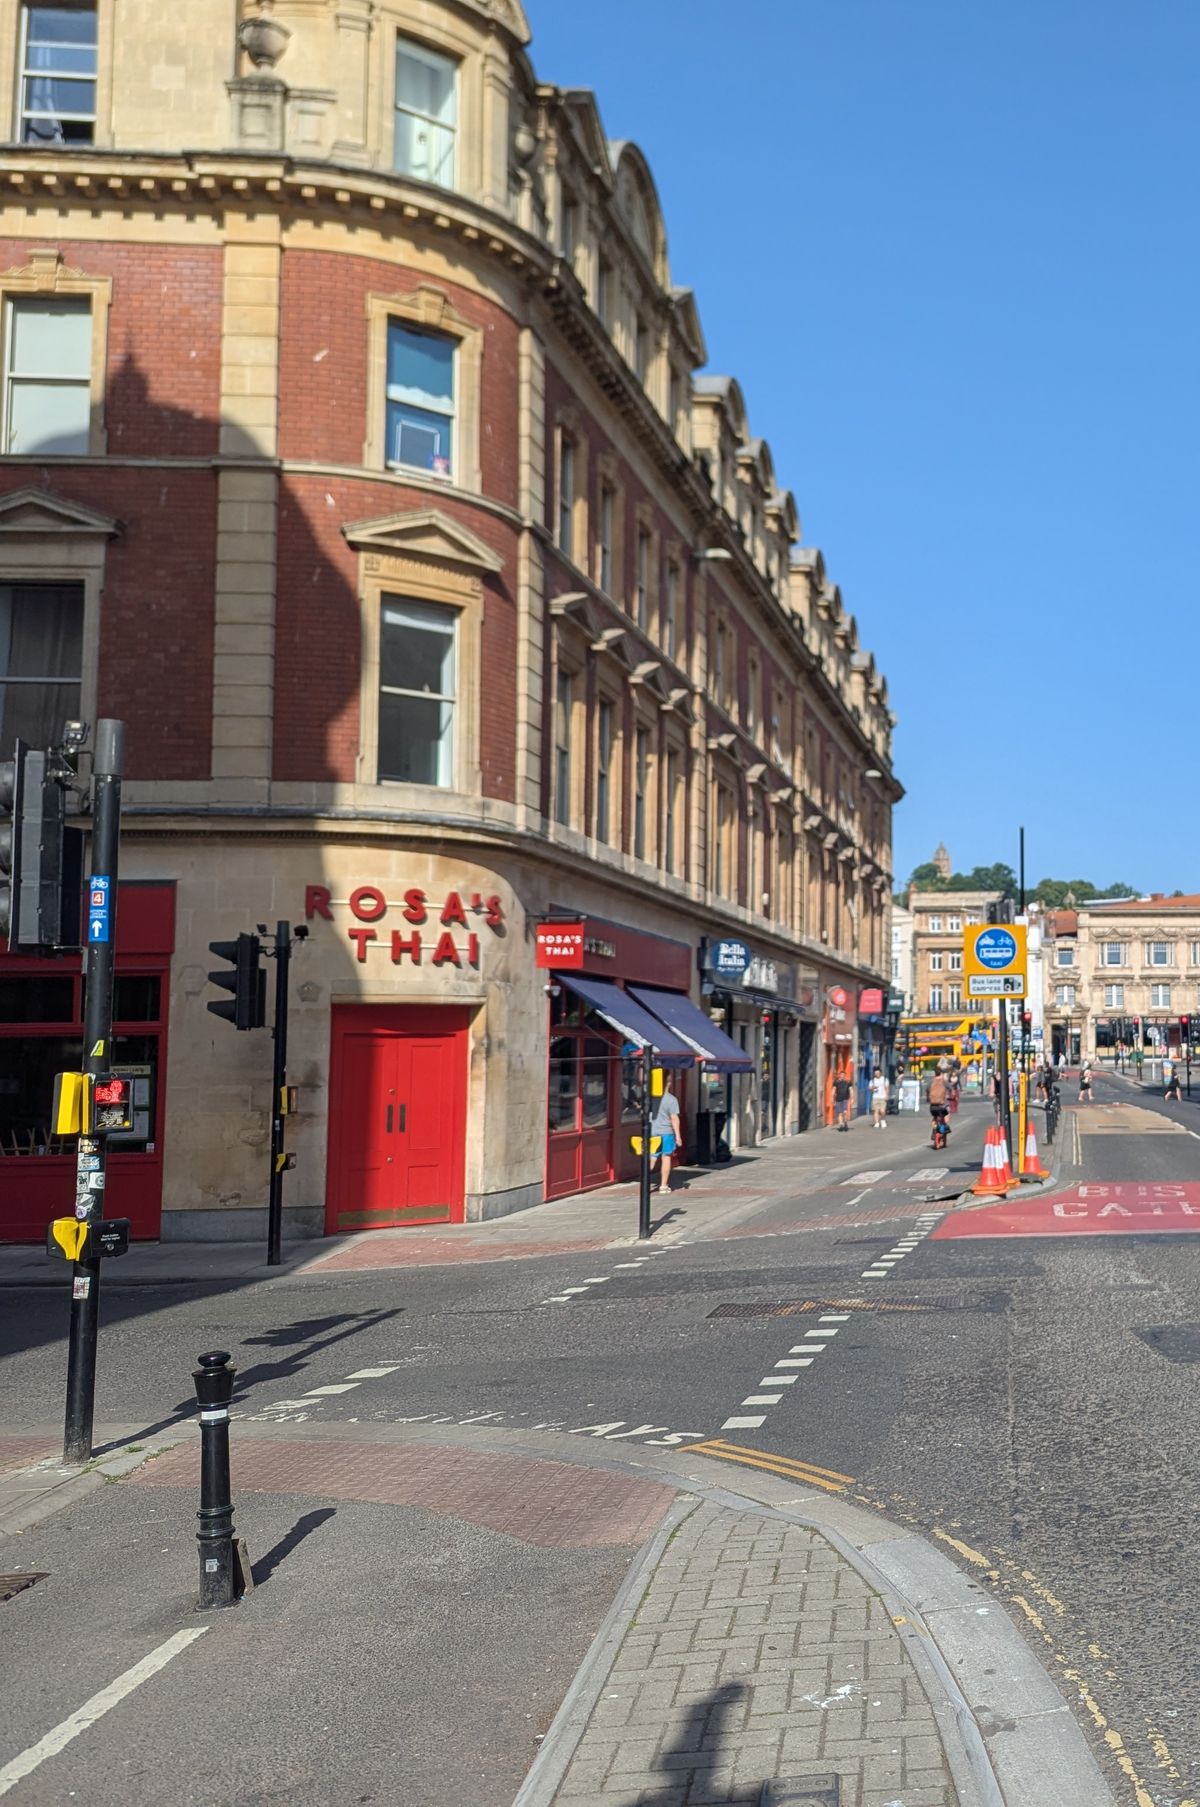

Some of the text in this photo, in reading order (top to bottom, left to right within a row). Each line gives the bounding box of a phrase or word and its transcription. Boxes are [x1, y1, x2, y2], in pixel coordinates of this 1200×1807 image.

[304, 884, 505, 929] ROSA'S
[537, 935, 582, 944] ROSA'S
[347, 927, 480, 968] THAI
[545, 946, 574, 956] THAI
[719, 943, 746, 955] Bella
[718, 955, 746, 966] Italia
[1078, 1185, 1187, 1198] BUS
